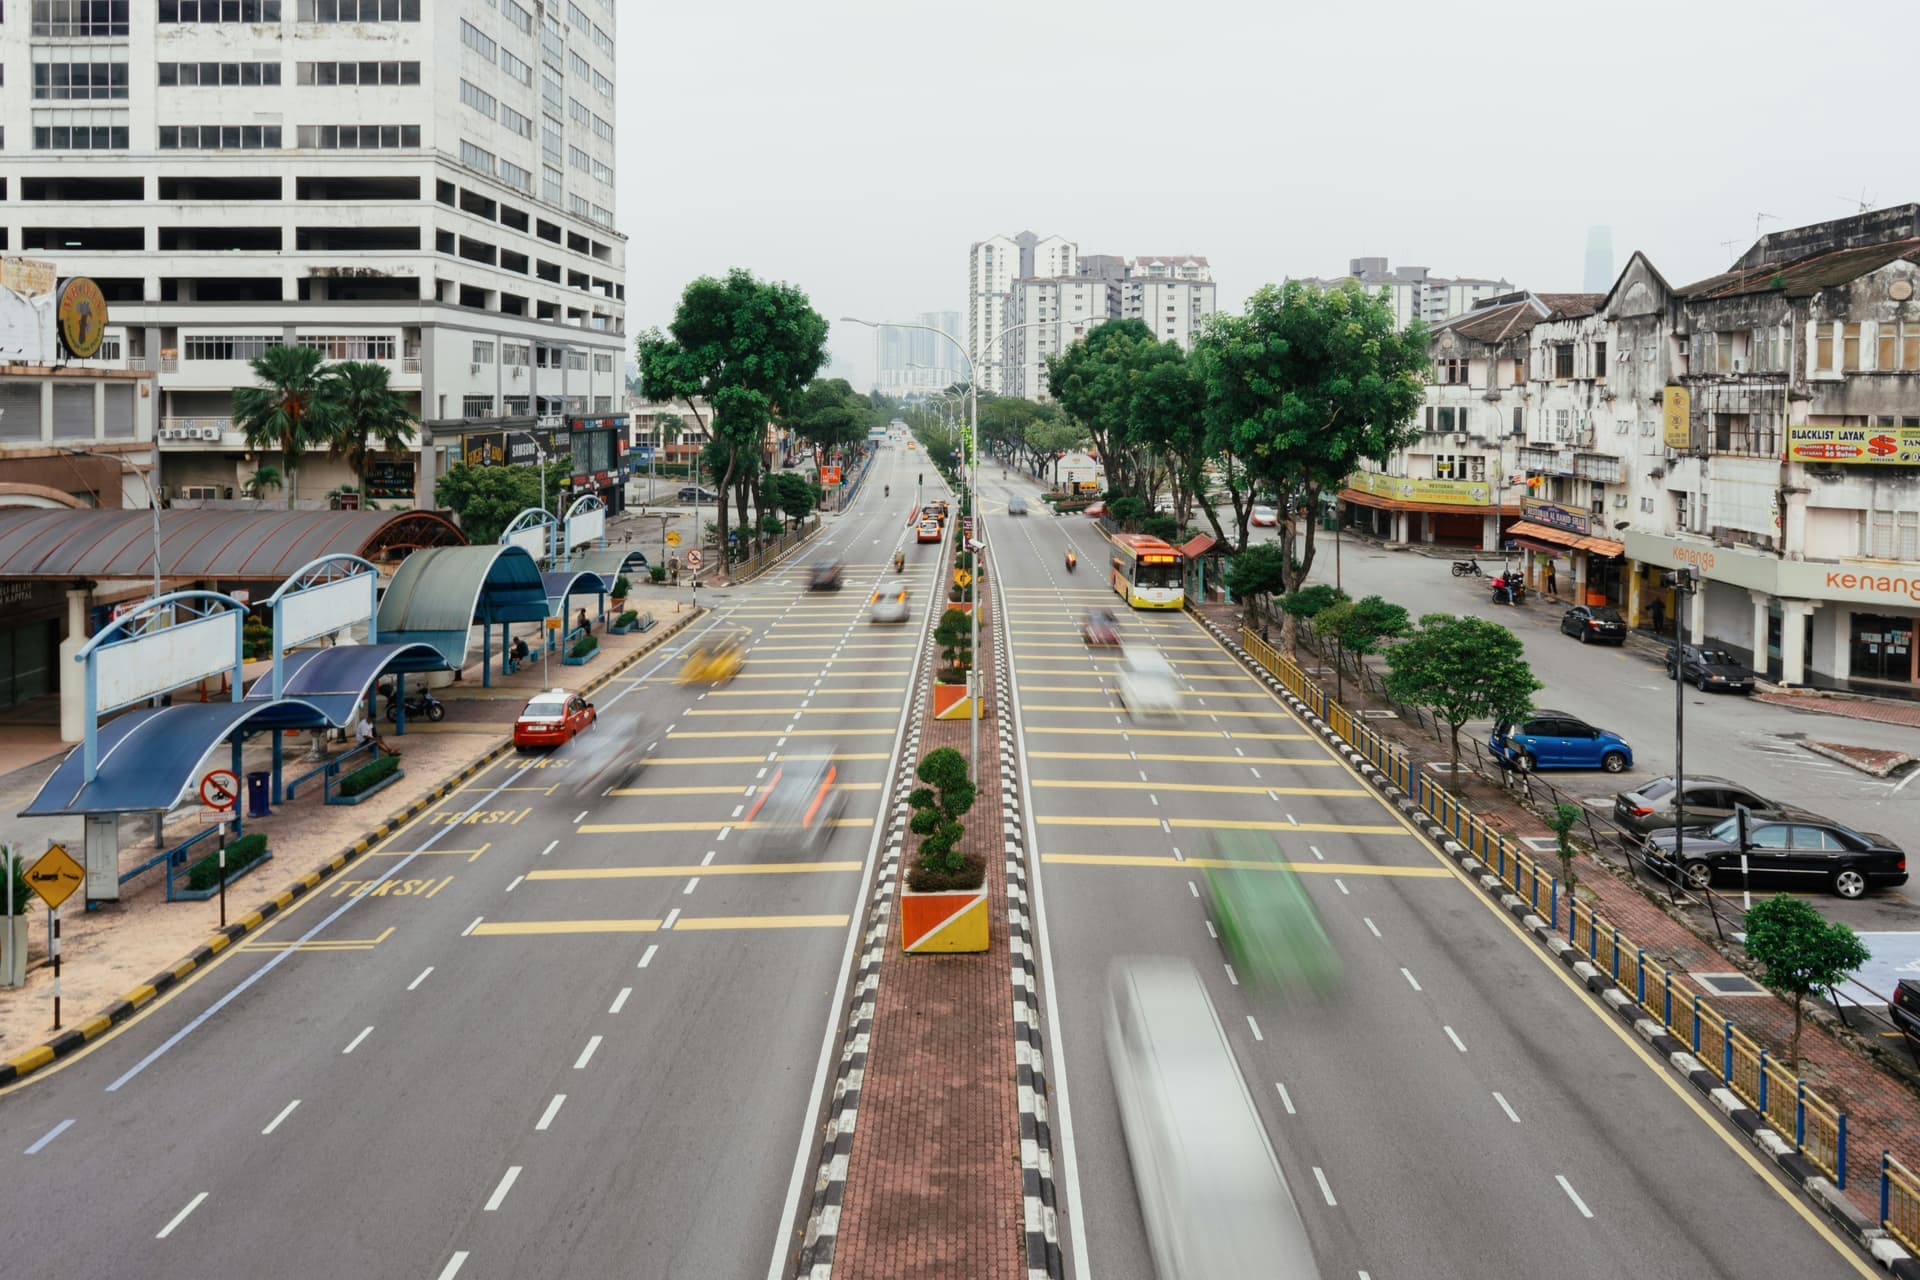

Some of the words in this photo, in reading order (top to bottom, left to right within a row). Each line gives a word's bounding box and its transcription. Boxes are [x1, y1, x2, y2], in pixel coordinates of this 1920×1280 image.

[1791, 429, 1834, 440] BLACKLIST
[1838, 431, 1865, 441] LAYAK
[512, 442, 536, 458] SAMSUNG
[504, 758, 576, 769] TEKSI
[429, 809, 516, 825] TEKSI
[330, 877, 436, 899] TEKSI
